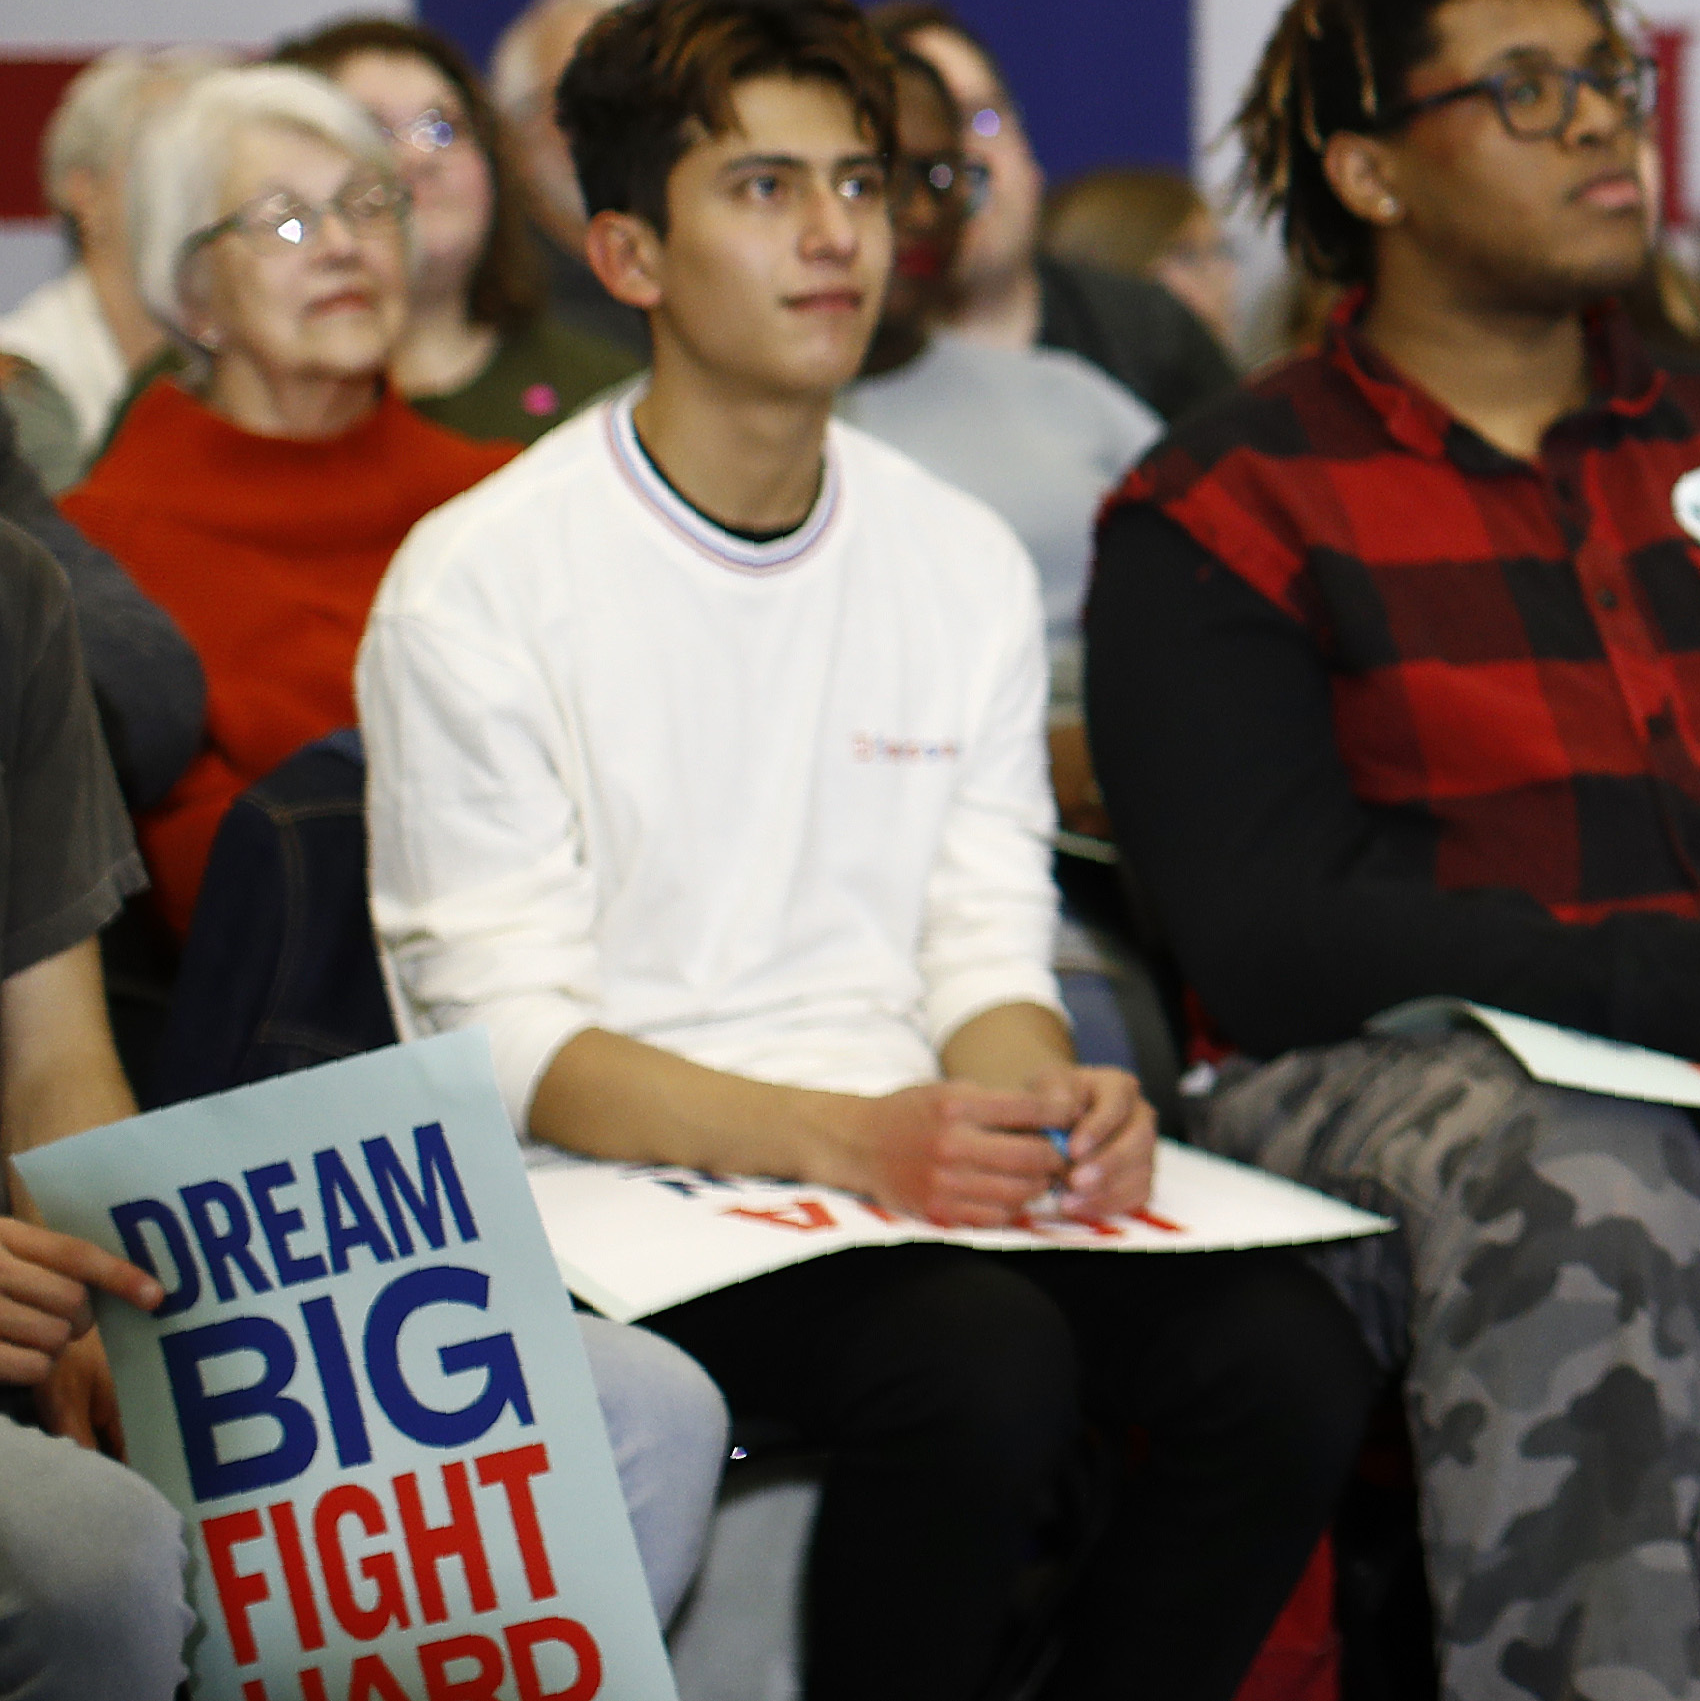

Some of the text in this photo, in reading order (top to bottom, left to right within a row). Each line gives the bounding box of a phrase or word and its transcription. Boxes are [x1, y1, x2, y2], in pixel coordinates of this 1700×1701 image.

[110, 1121, 480, 1319] DREAM
[160, 1266, 536, 1504] BIG
[200, 1443, 558, 1667] FIGHT
